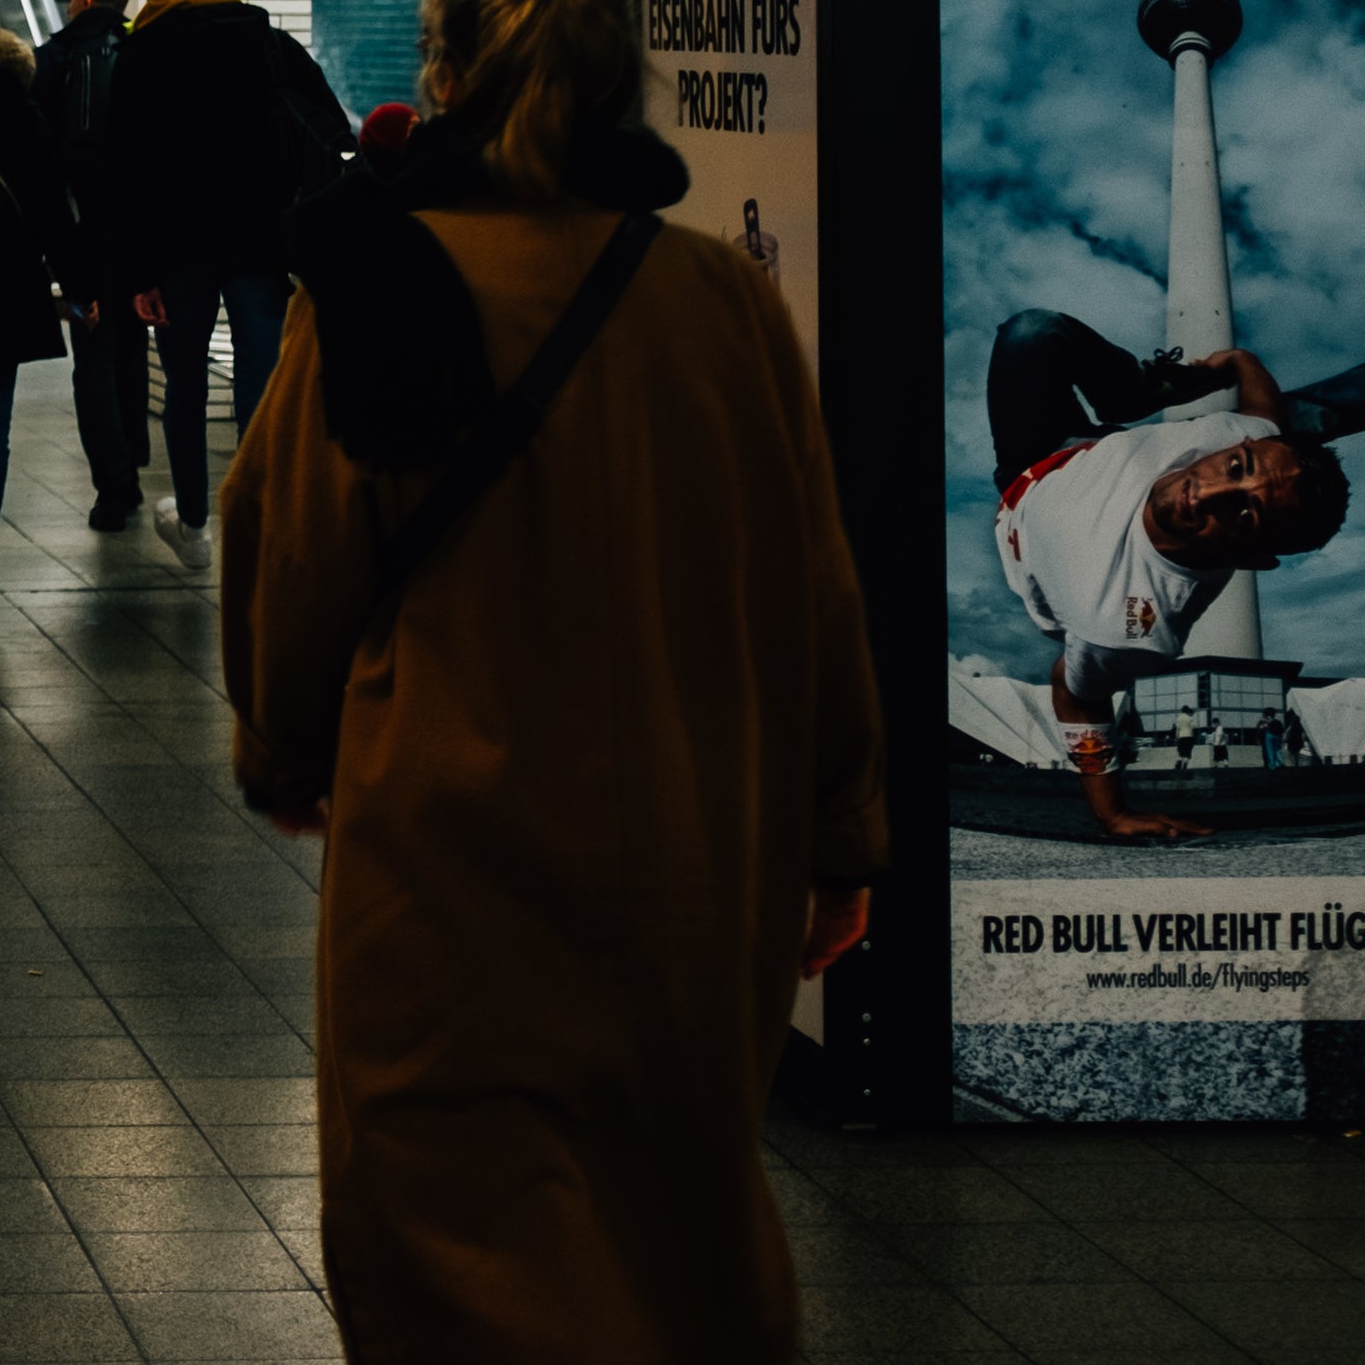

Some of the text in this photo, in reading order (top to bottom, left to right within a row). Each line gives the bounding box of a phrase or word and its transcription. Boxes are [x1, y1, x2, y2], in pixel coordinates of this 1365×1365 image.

[677, 70, 769, 135] PROJEKT?
[983, 915, 1044, 953] RED
[1052, 914, 1129, 953] BULL
[1132, 912, 1281, 952] VERLEIHT
[1086, 962, 1311, 993] www.redbull.de/flyingsteps
